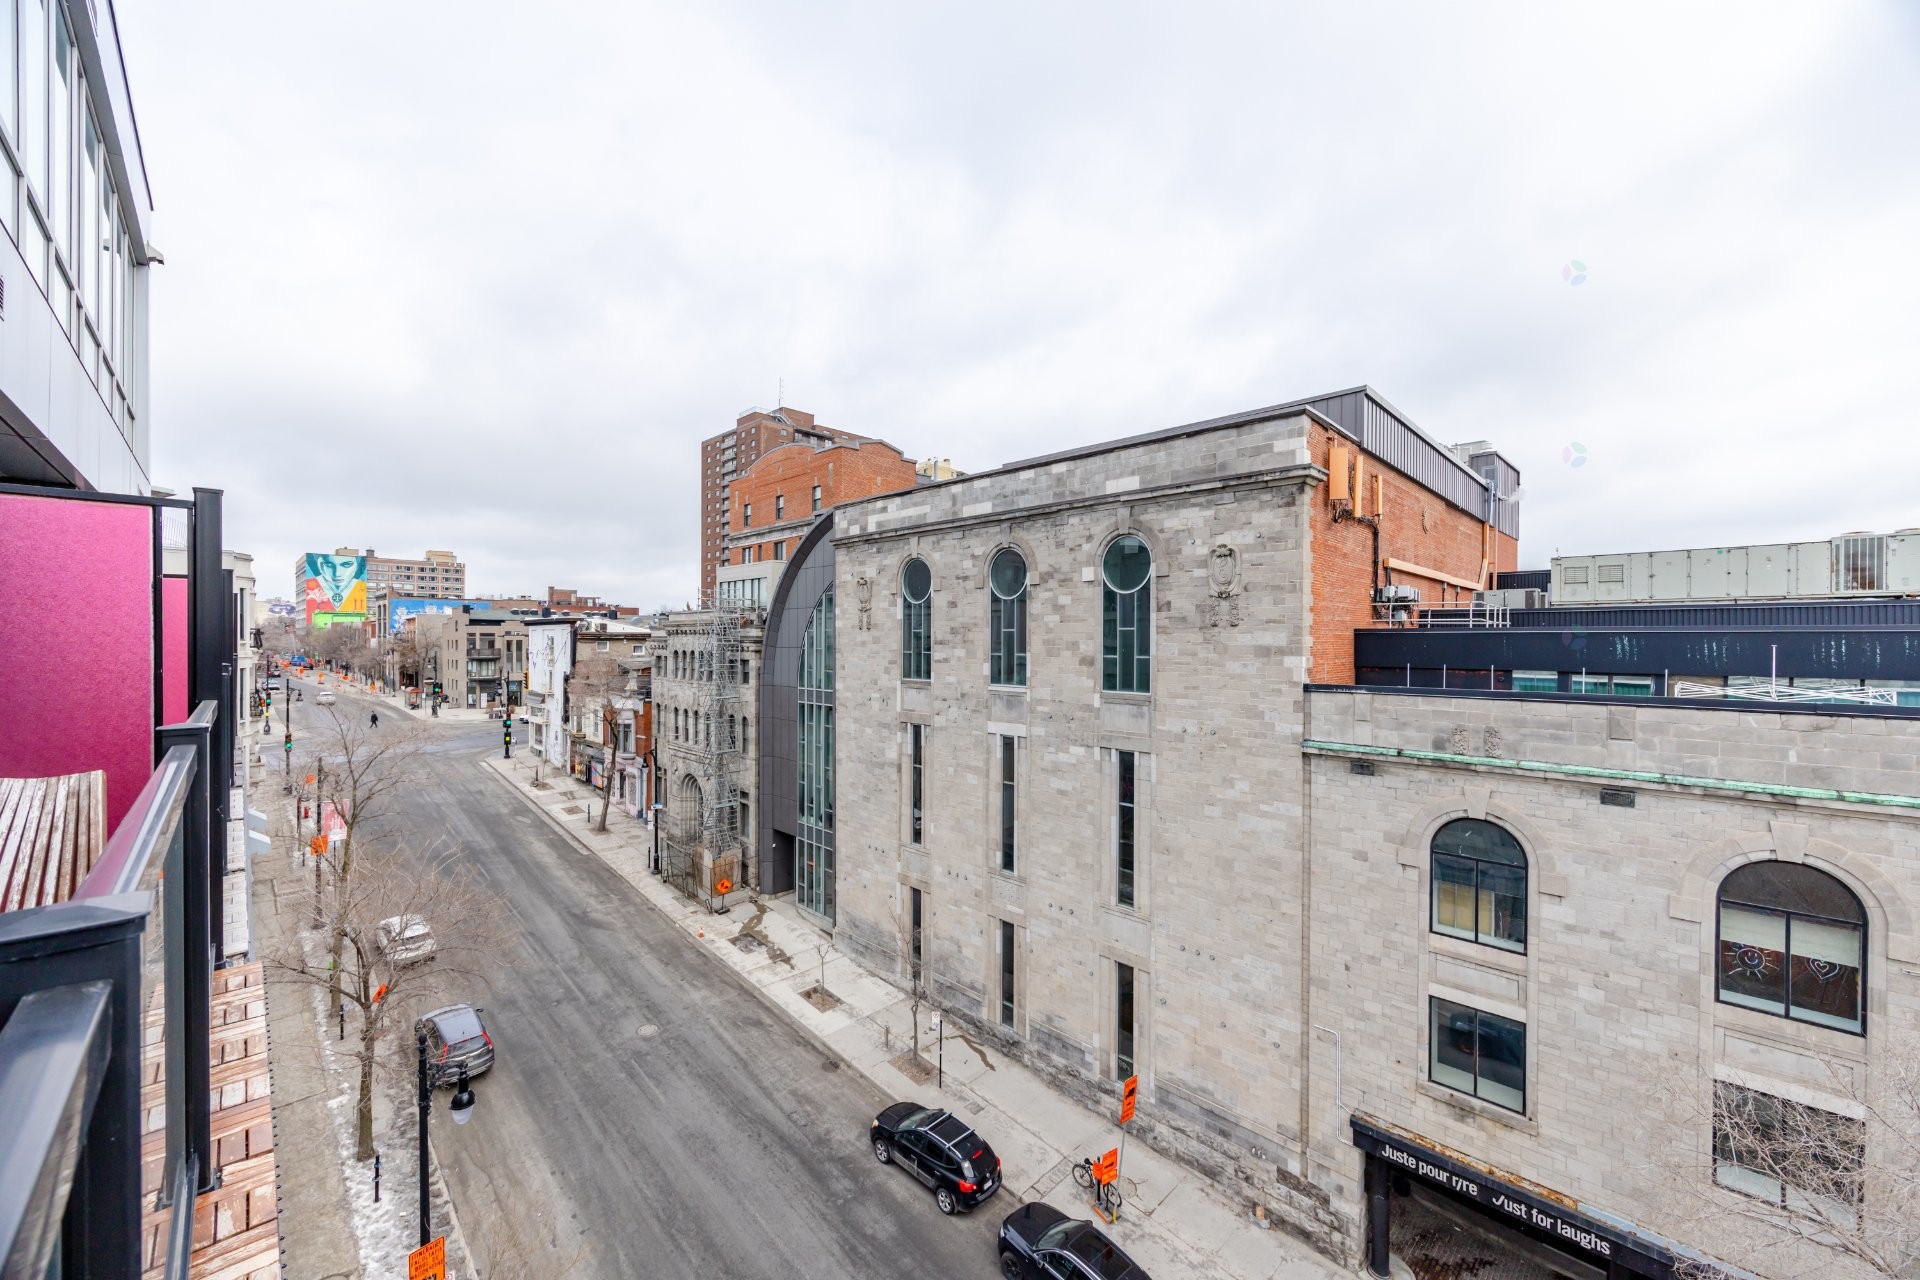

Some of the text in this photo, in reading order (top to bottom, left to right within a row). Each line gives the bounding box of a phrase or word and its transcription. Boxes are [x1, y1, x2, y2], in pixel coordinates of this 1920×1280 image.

[1381, 1144, 1416, 1169] Juste
[1418, 1160, 1449, 1183] pour
[1492, 1194, 1611, 1255] Just for laughs
